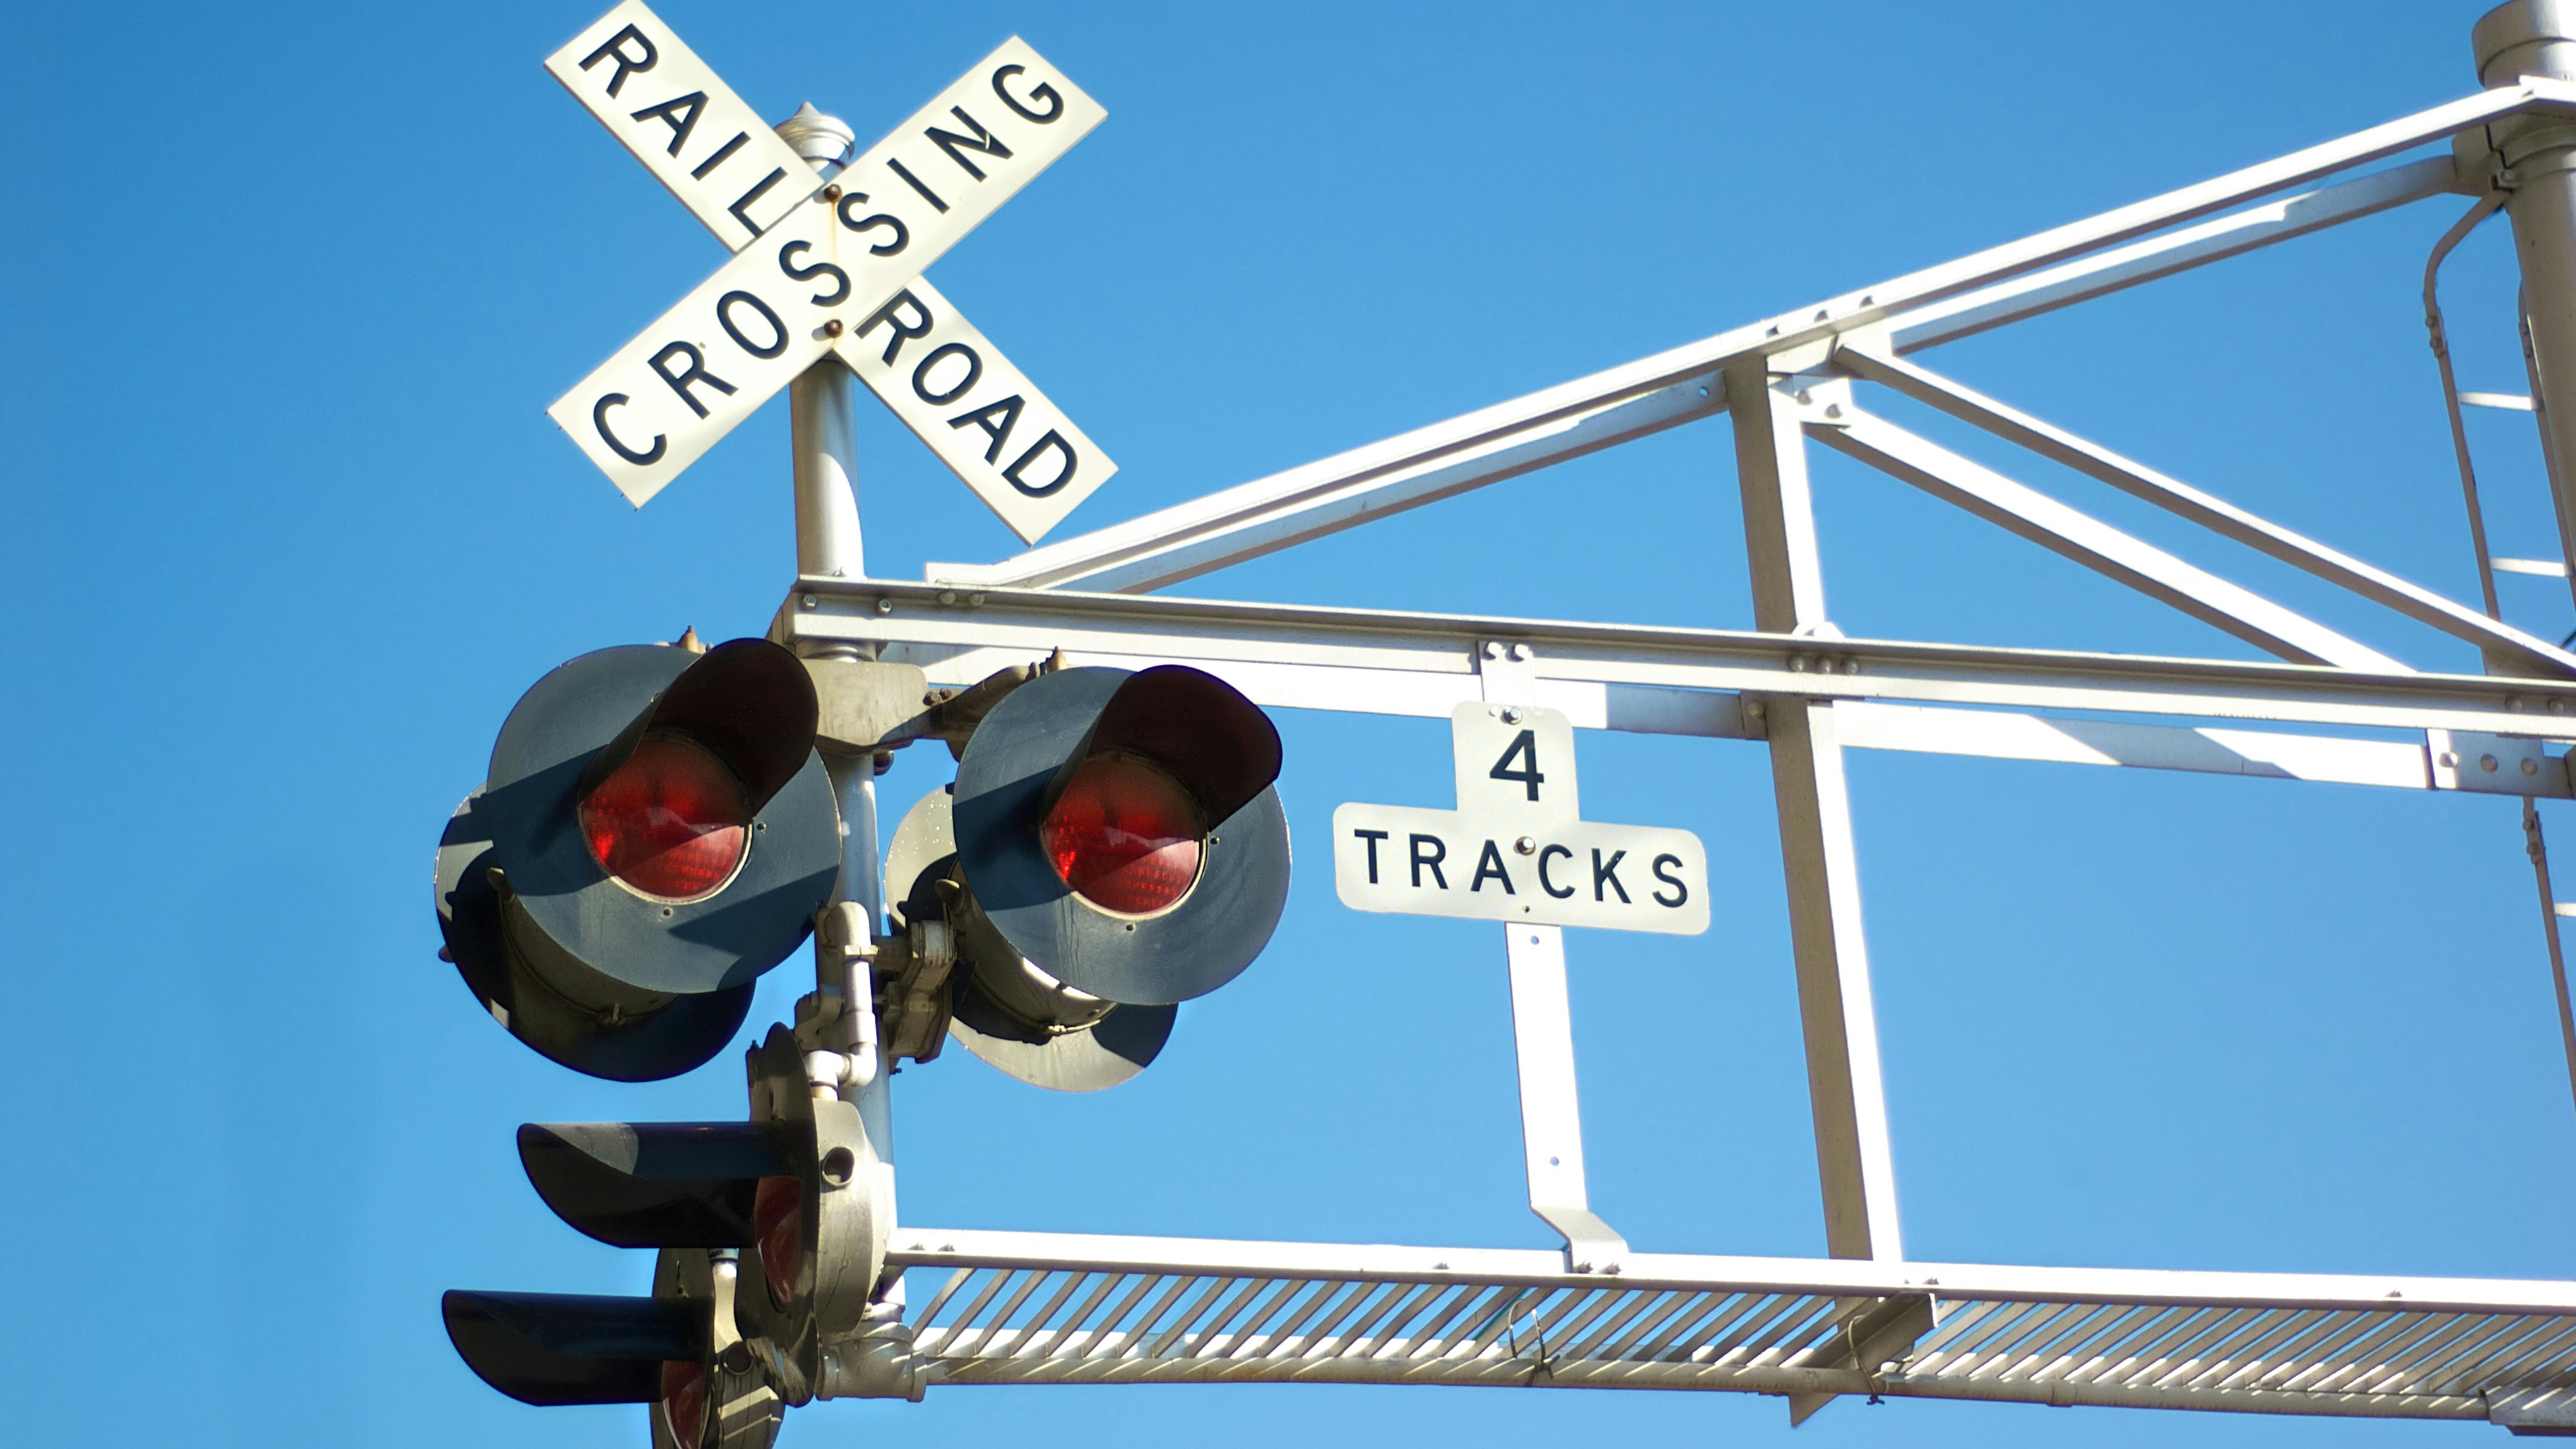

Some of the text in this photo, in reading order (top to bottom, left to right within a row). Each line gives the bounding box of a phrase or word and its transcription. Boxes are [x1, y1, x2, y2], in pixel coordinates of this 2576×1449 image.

[578, 22, 1078, 499] RAIL ROAD
[592, 63, 1064, 466] CROSSING
[1354, 829, 1688, 908] TRACKS
[1489, 729, 1544, 802] 4
